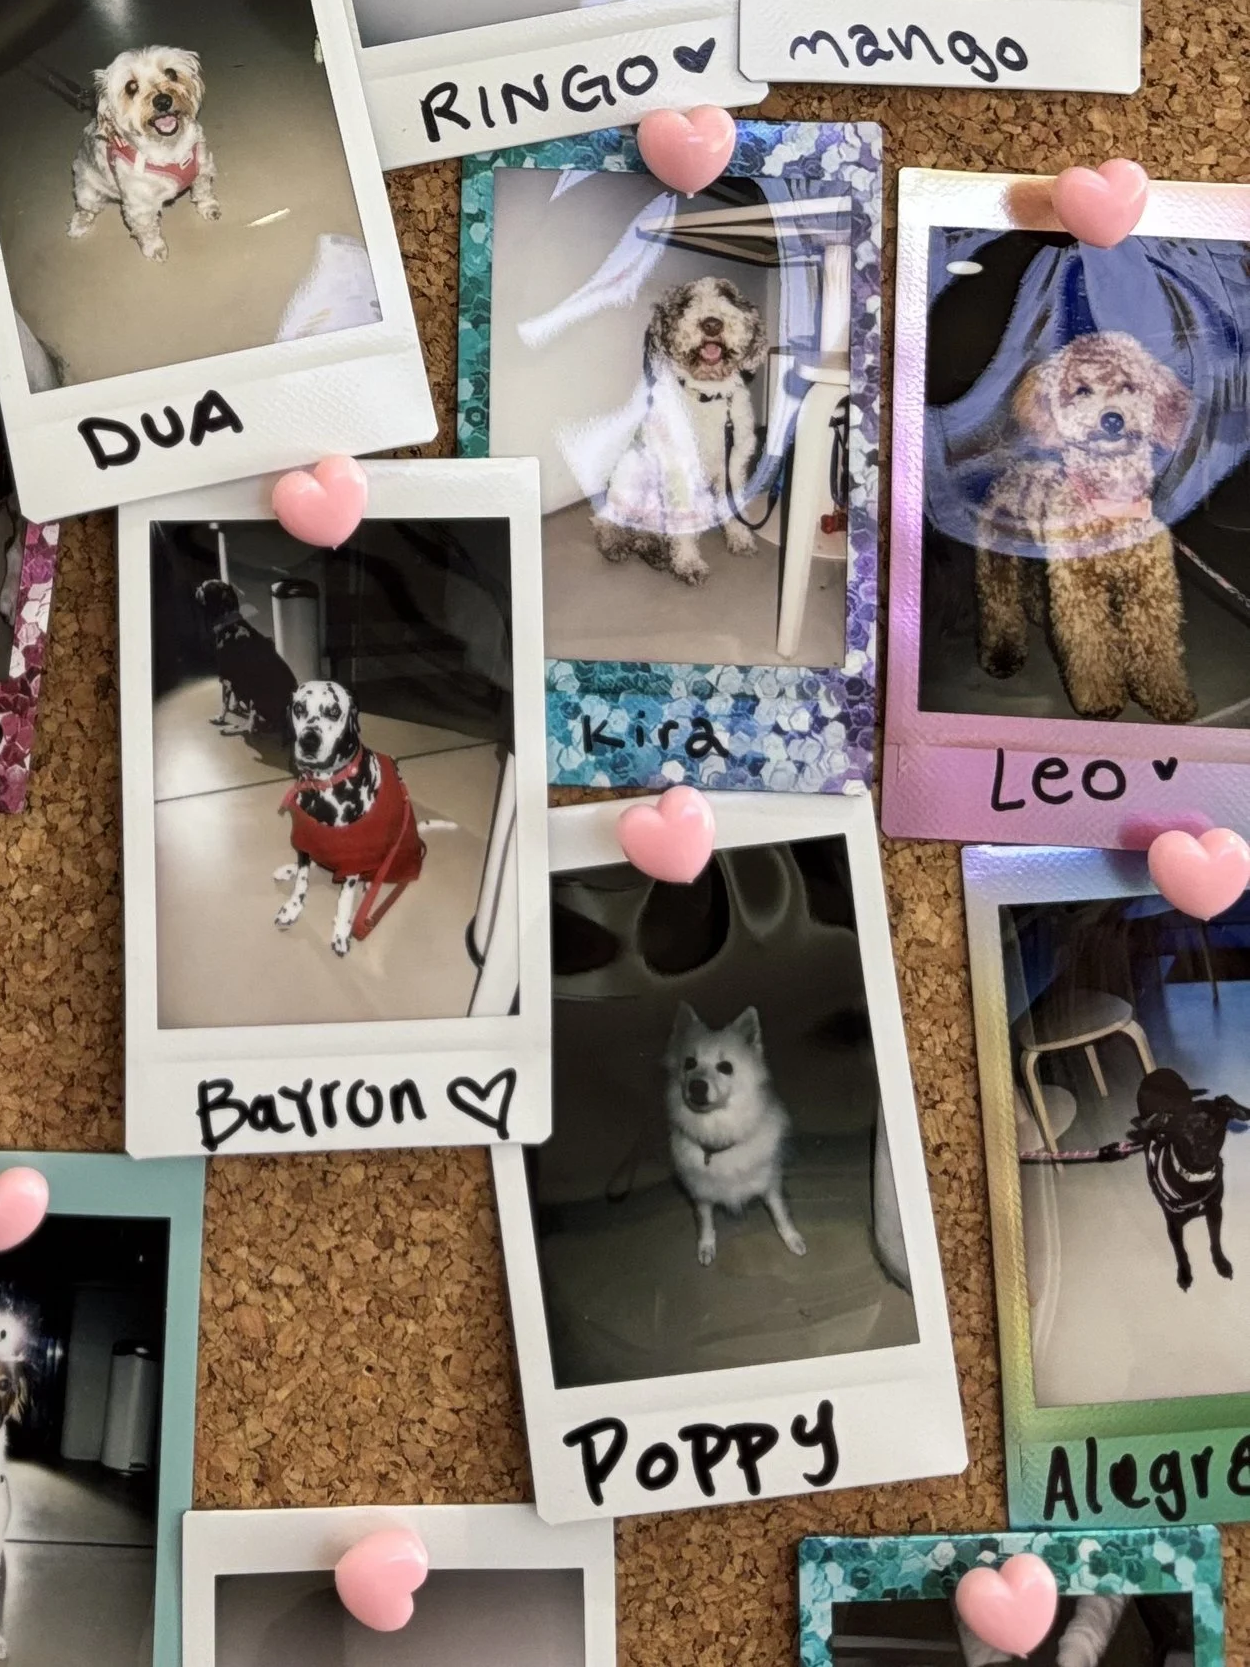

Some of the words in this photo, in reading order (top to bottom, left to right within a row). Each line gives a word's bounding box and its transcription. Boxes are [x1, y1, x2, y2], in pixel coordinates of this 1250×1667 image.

[789, 24, 1029, 83] mango
[419, 54, 659, 143] RINGO
[77, 389, 244, 471] DUA
[991, 747, 1127, 812] Leo
